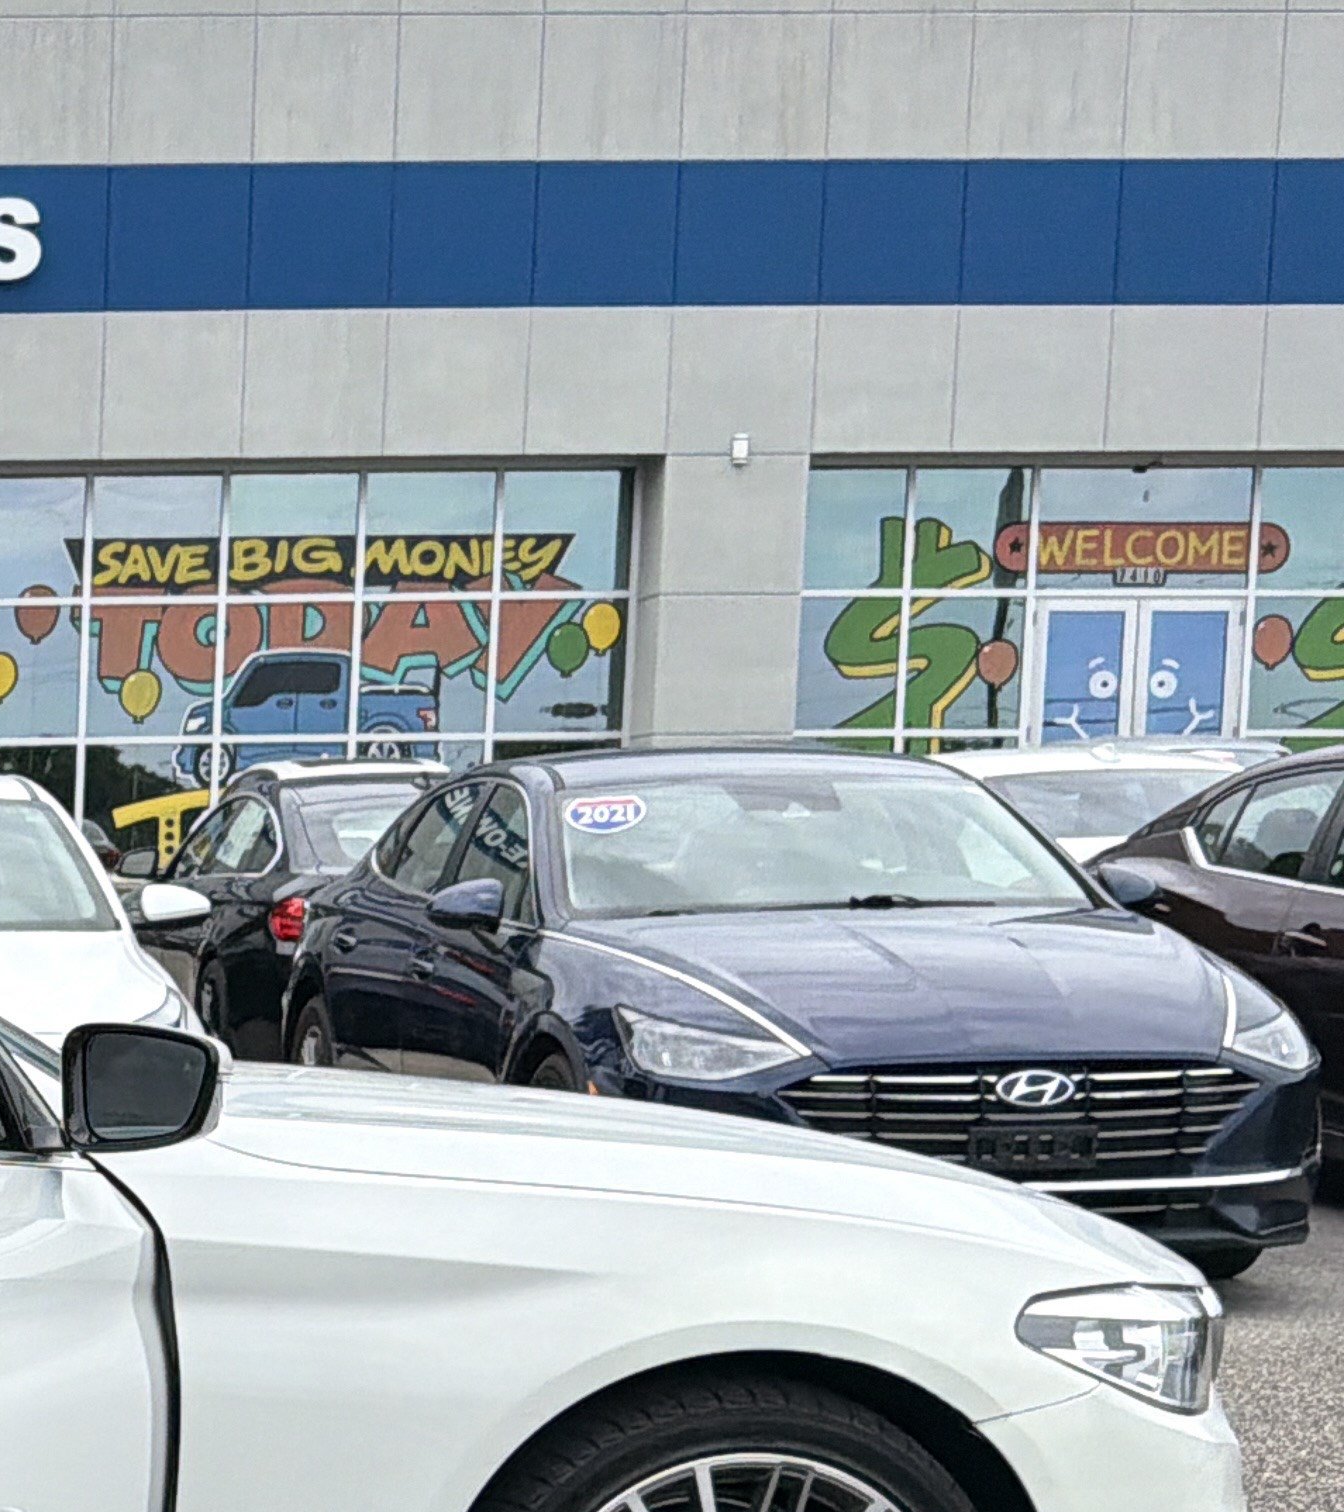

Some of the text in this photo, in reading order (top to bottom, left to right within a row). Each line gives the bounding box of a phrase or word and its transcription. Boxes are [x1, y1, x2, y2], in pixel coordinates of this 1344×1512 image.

[91, 534, 564, 586] SAVE BIG MONEY
[1038, 528, 1250, 567] WELCOME
[80, 578, 582, 695] TODAY
[576, 804, 635, 825] 2021
